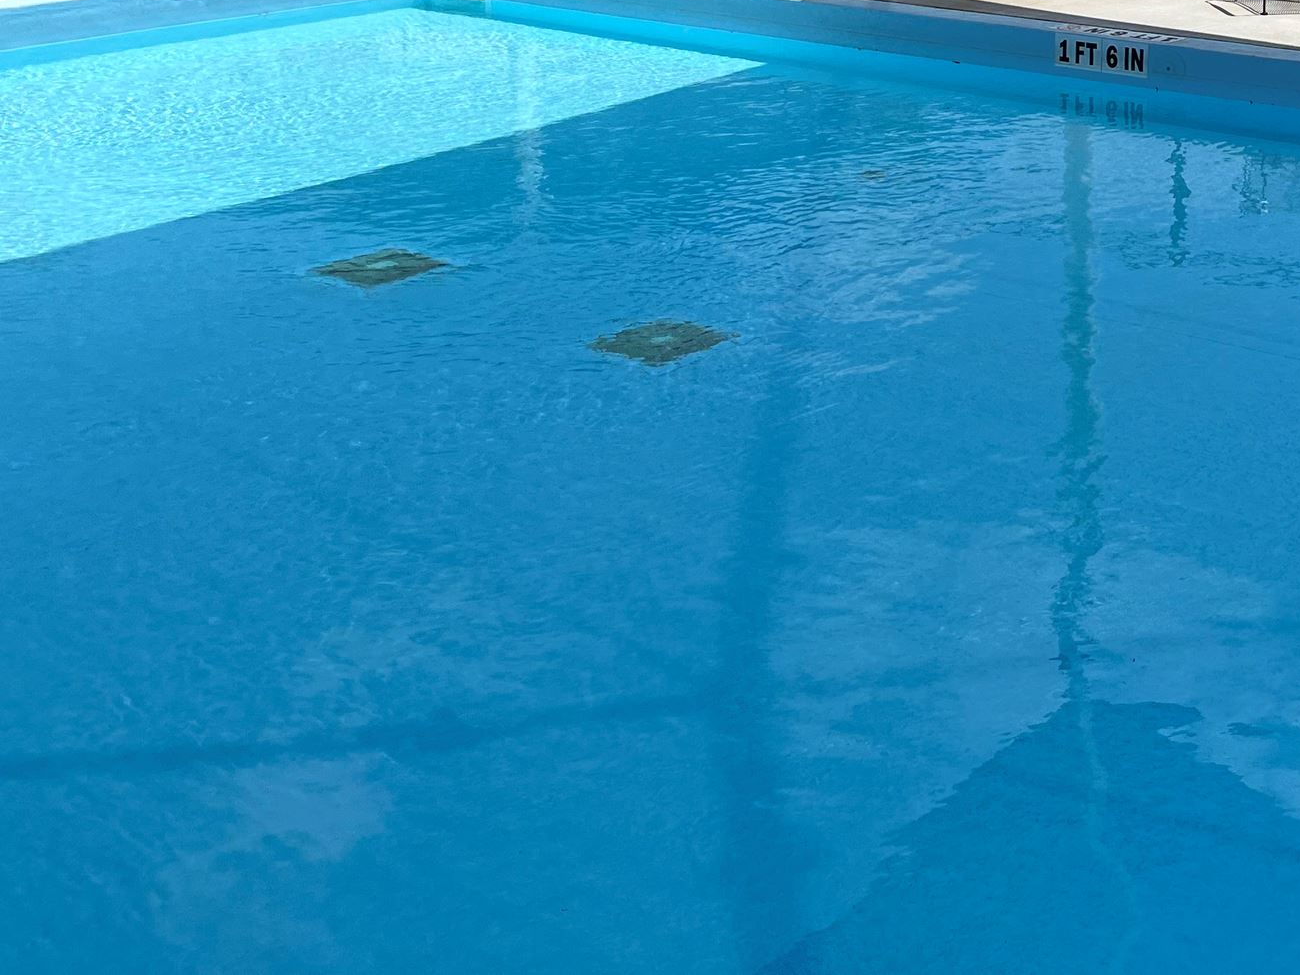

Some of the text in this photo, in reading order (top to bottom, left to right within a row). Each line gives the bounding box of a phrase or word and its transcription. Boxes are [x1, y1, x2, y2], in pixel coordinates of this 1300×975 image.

[1059, 39, 1145, 73] 1 FT 6 IN
